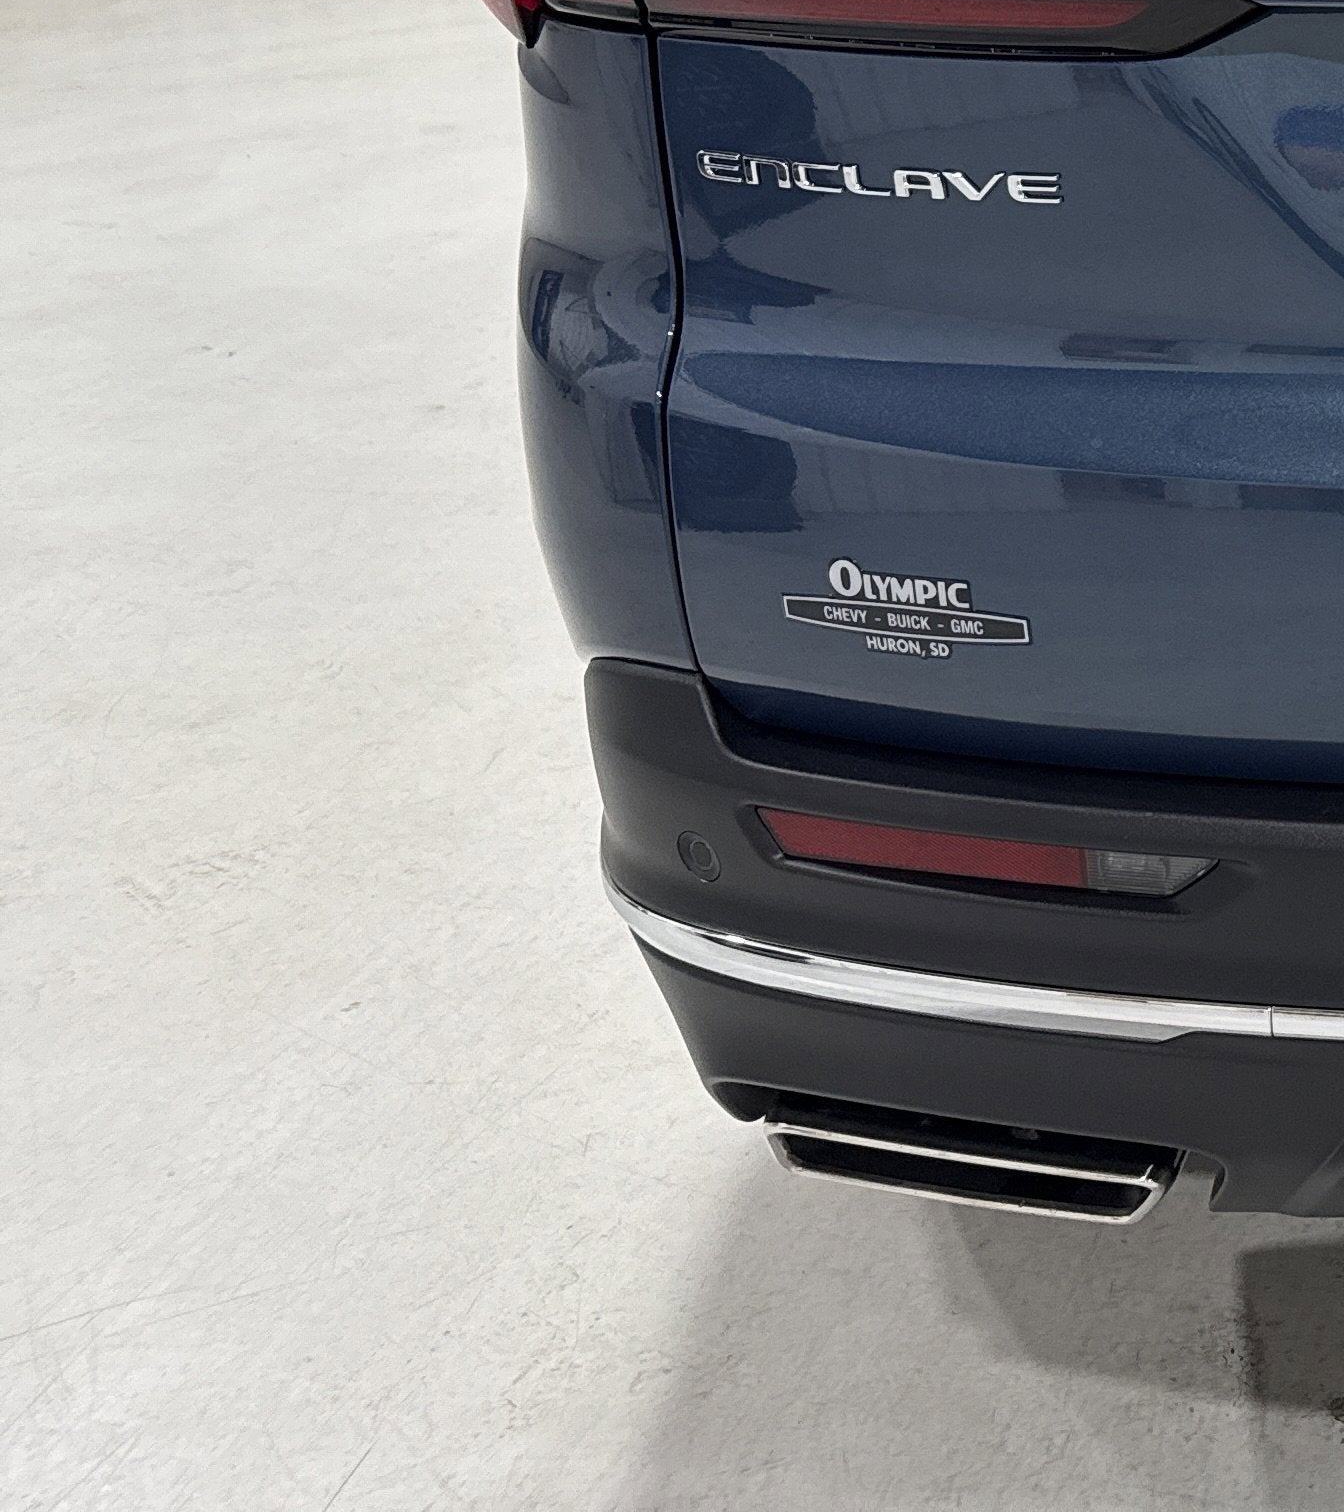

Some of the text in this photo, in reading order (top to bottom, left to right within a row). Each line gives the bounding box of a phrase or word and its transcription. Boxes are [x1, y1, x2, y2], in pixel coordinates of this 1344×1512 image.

[696, 149, 1064, 205] ENCLAVE
[823, 604, 868, 625] CHEVY
[887, 613, 931, 631] BUICK
[950, 618, 984, 636] GMC
[865, 635, 950, 657] HURON, SD
